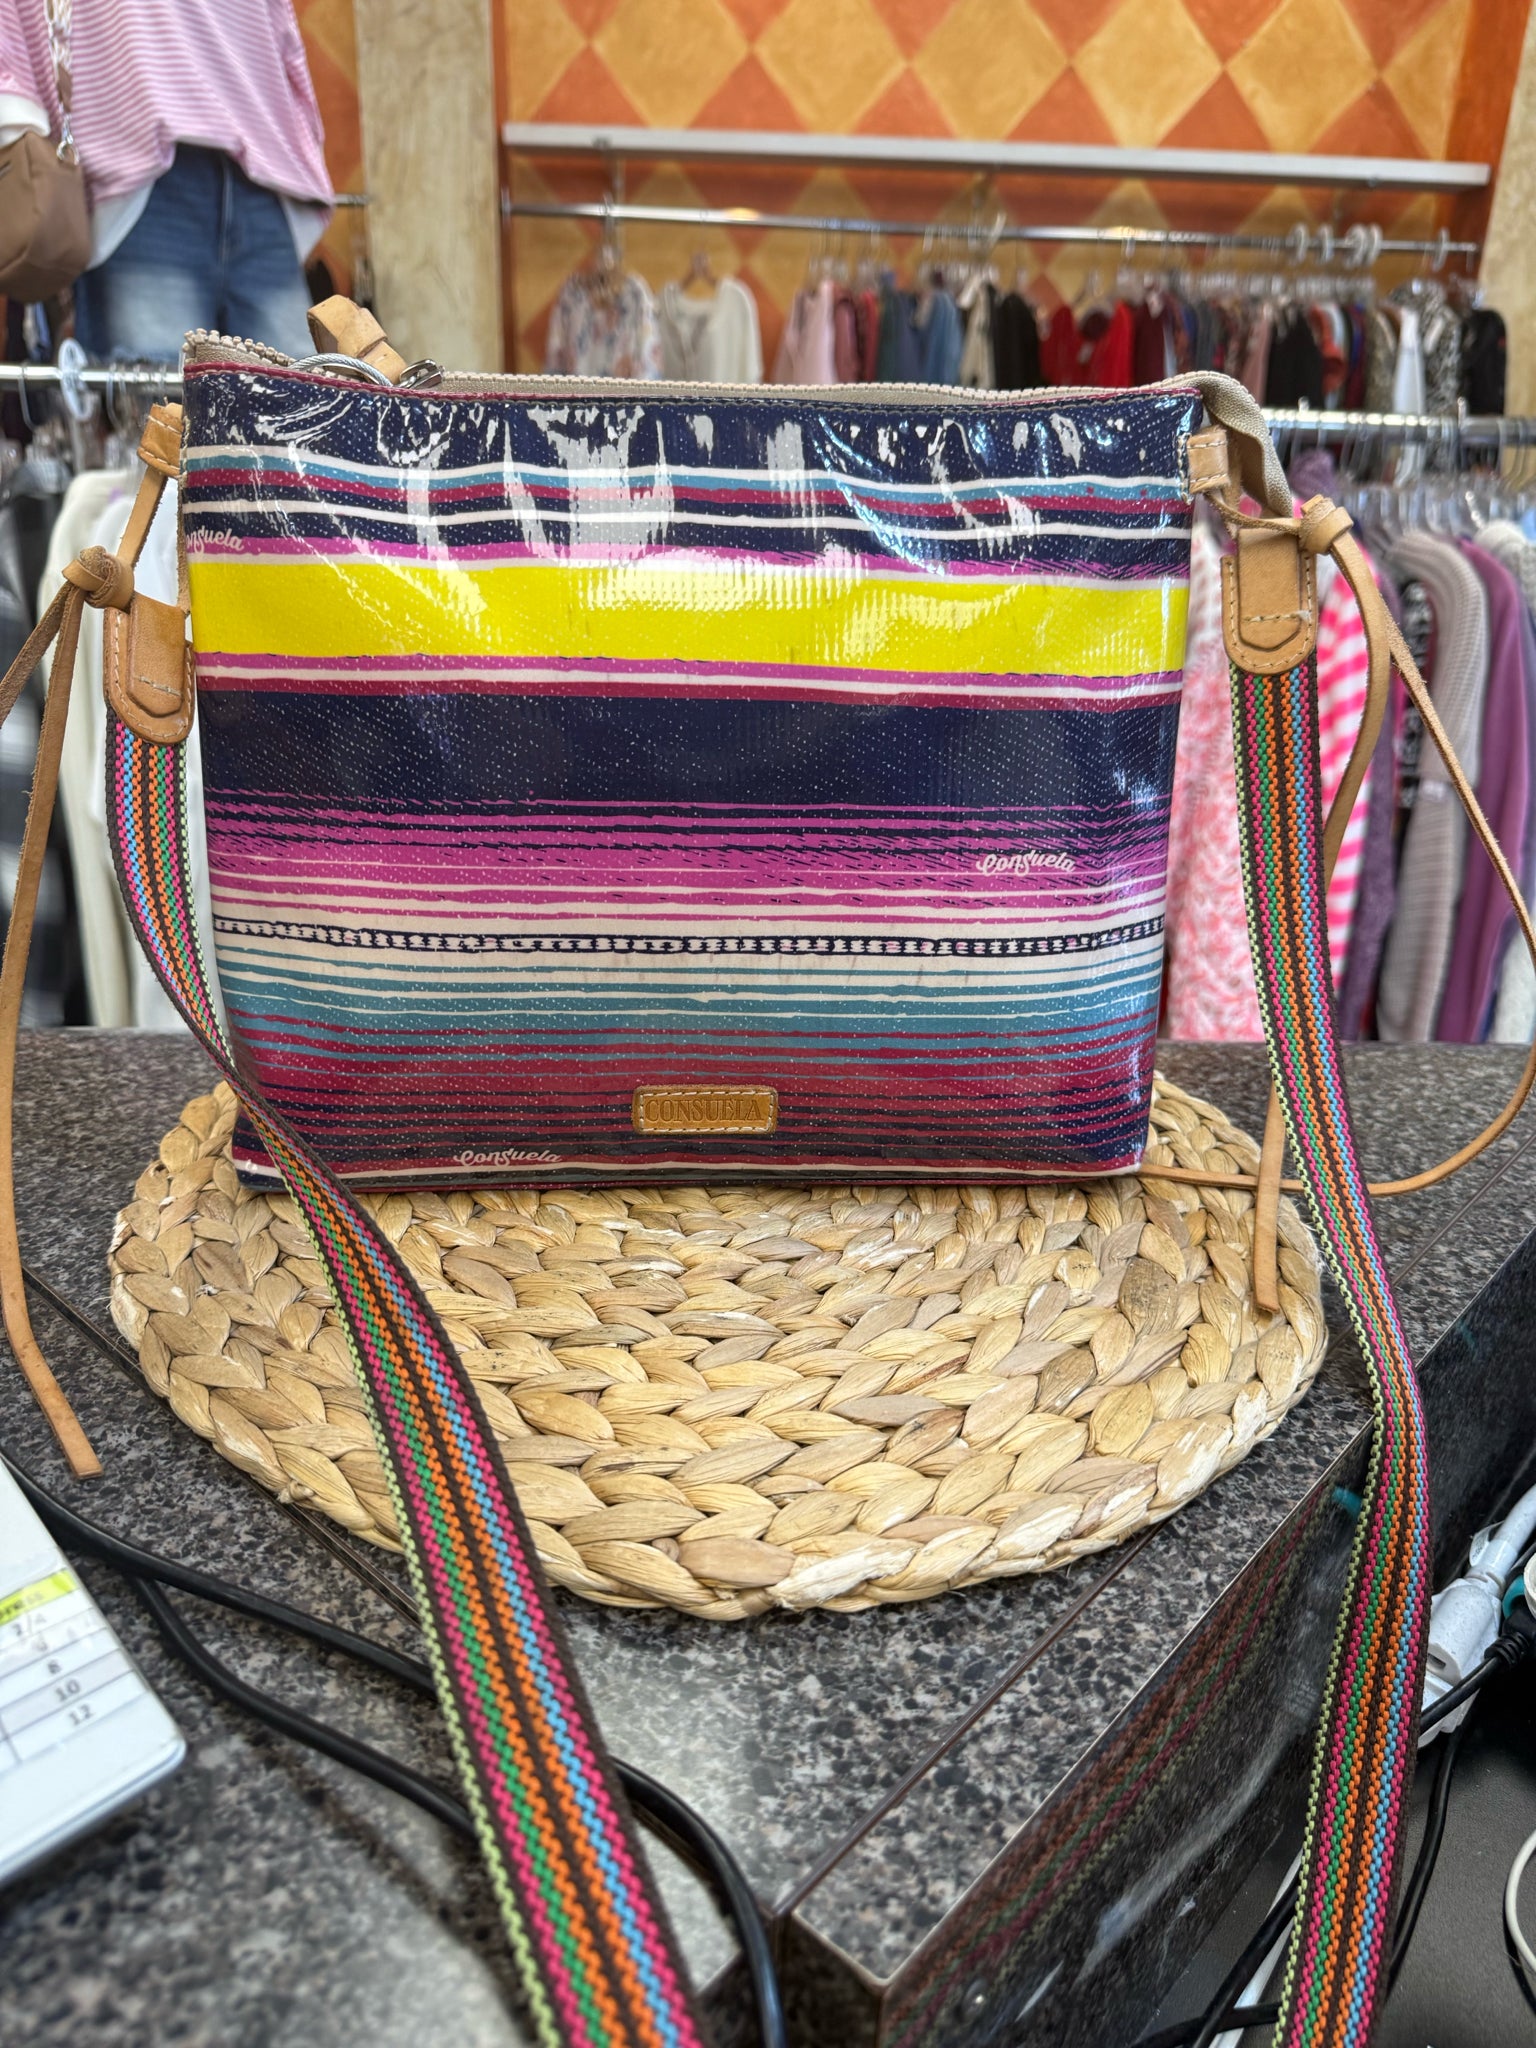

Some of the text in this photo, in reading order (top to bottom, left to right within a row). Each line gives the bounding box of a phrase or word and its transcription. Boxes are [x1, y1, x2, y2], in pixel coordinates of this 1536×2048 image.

[976, 849, 1076, 876] Consuela
[645, 1098, 764, 1122] CONSUELA
[453, 1148, 562, 1167] Consuela
[55, 1679, 82, 1702] 10
[69, 1704, 95, 1727] 12
